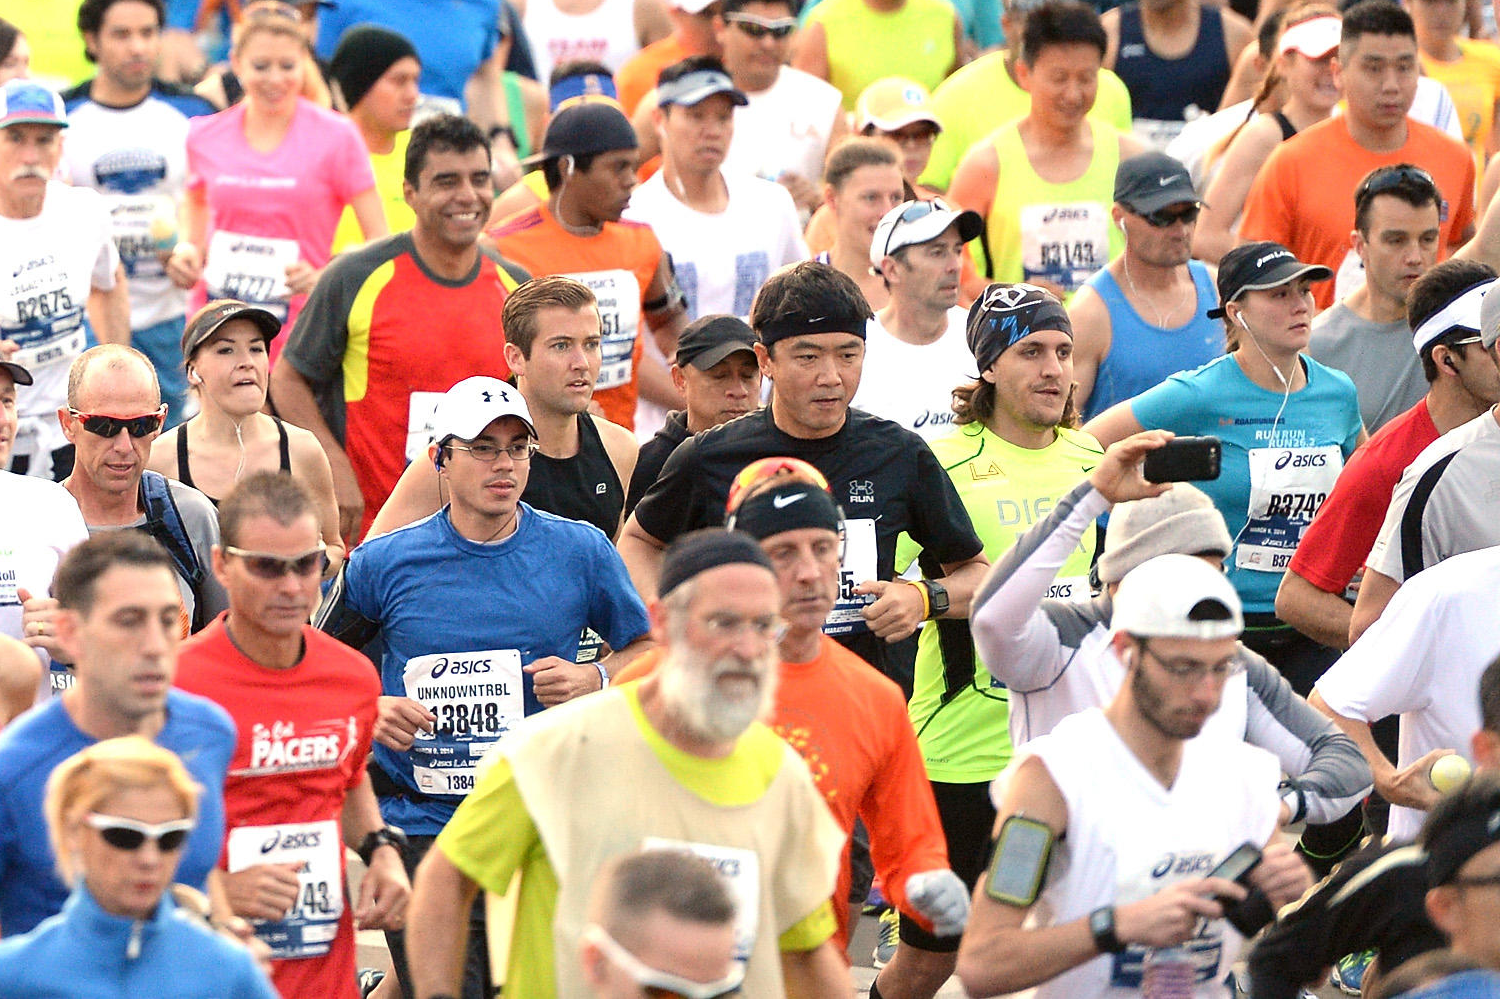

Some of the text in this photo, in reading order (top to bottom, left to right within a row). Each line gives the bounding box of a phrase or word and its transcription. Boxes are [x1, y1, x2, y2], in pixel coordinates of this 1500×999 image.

[16, 286, 72, 324] B2675
[930, 412, 956, 426] asic
[1293, 454, 1327, 467] asics
[850, 495, 874, 503] RUN
[450, 659, 492, 674] asics
[417, 683, 511, 700] UNKNOWNTRBL
[430, 702, 499, 734] 13848
[251, 734, 340, 768] PACERS
[446, 774, 476, 790] 1384
[281, 831, 321, 850] asics
